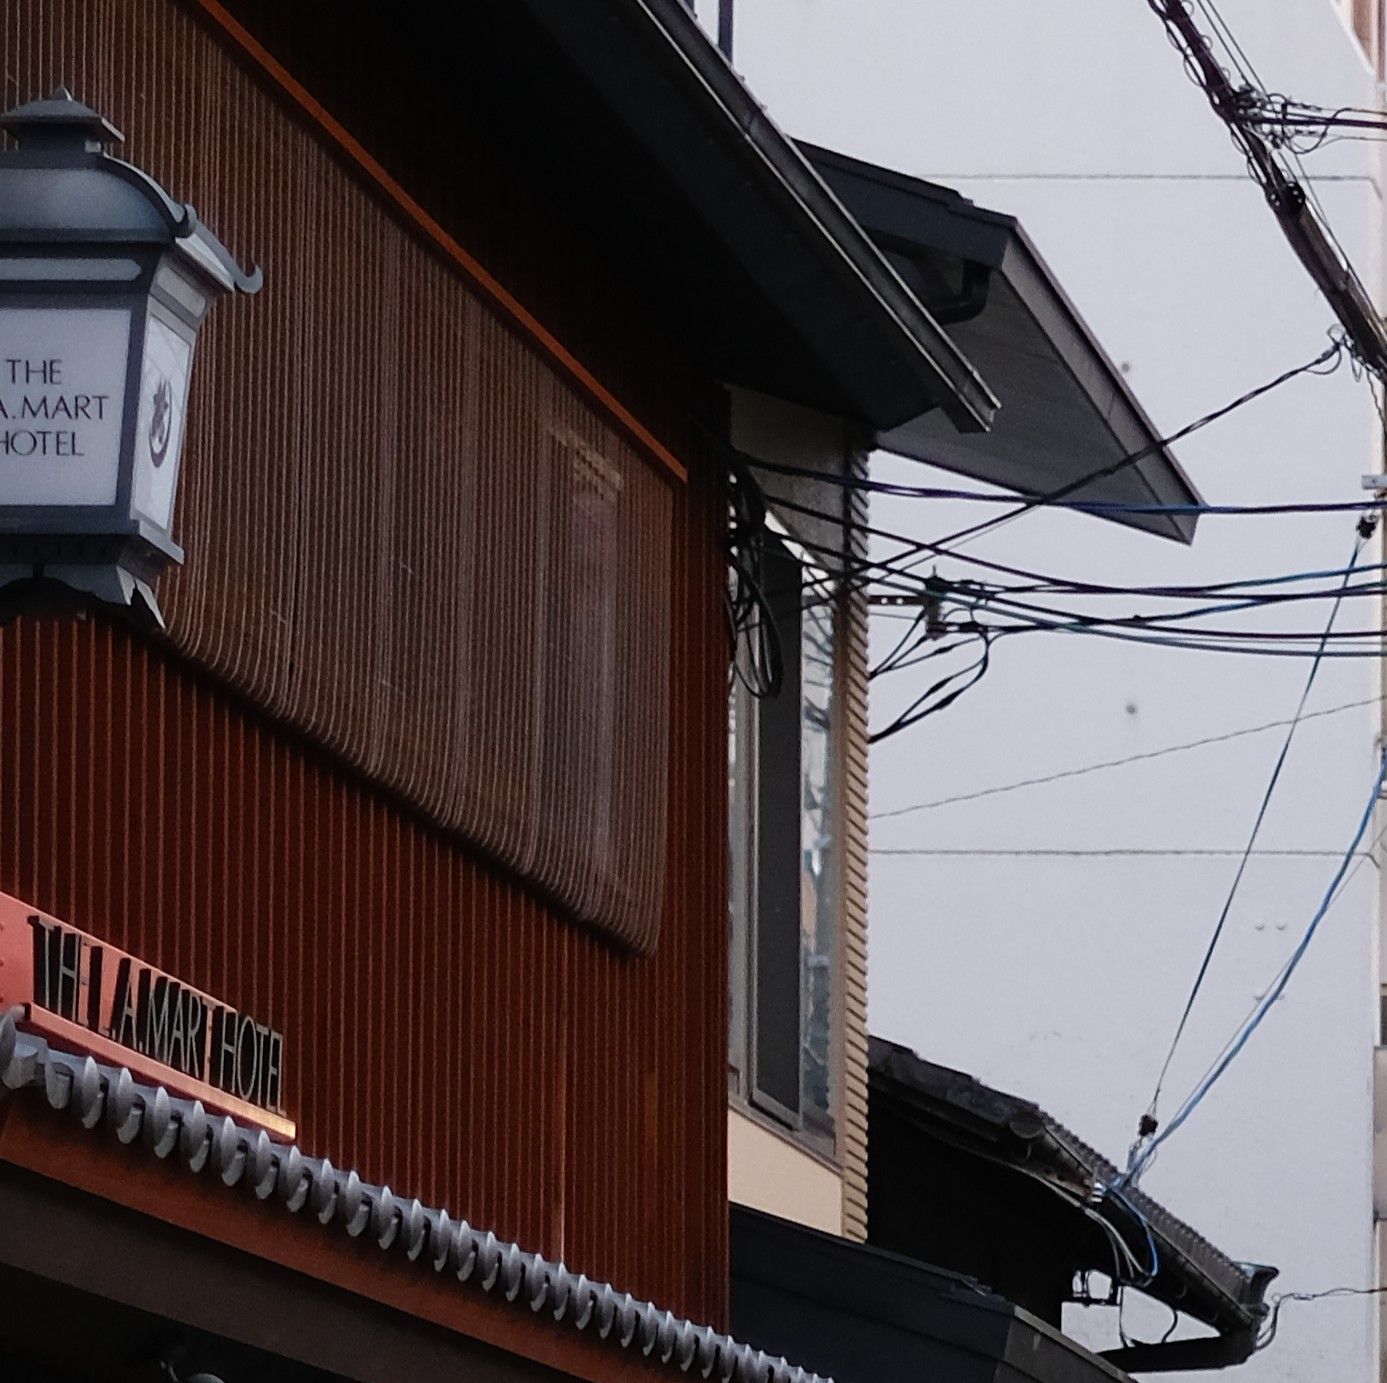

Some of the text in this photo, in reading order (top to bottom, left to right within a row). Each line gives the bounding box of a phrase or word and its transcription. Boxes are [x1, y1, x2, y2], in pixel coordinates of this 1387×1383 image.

[6, 359, 62, 384] THE
[30, 916, 90, 1028] THE
[211, 1006, 287, 1119] HOTEL
